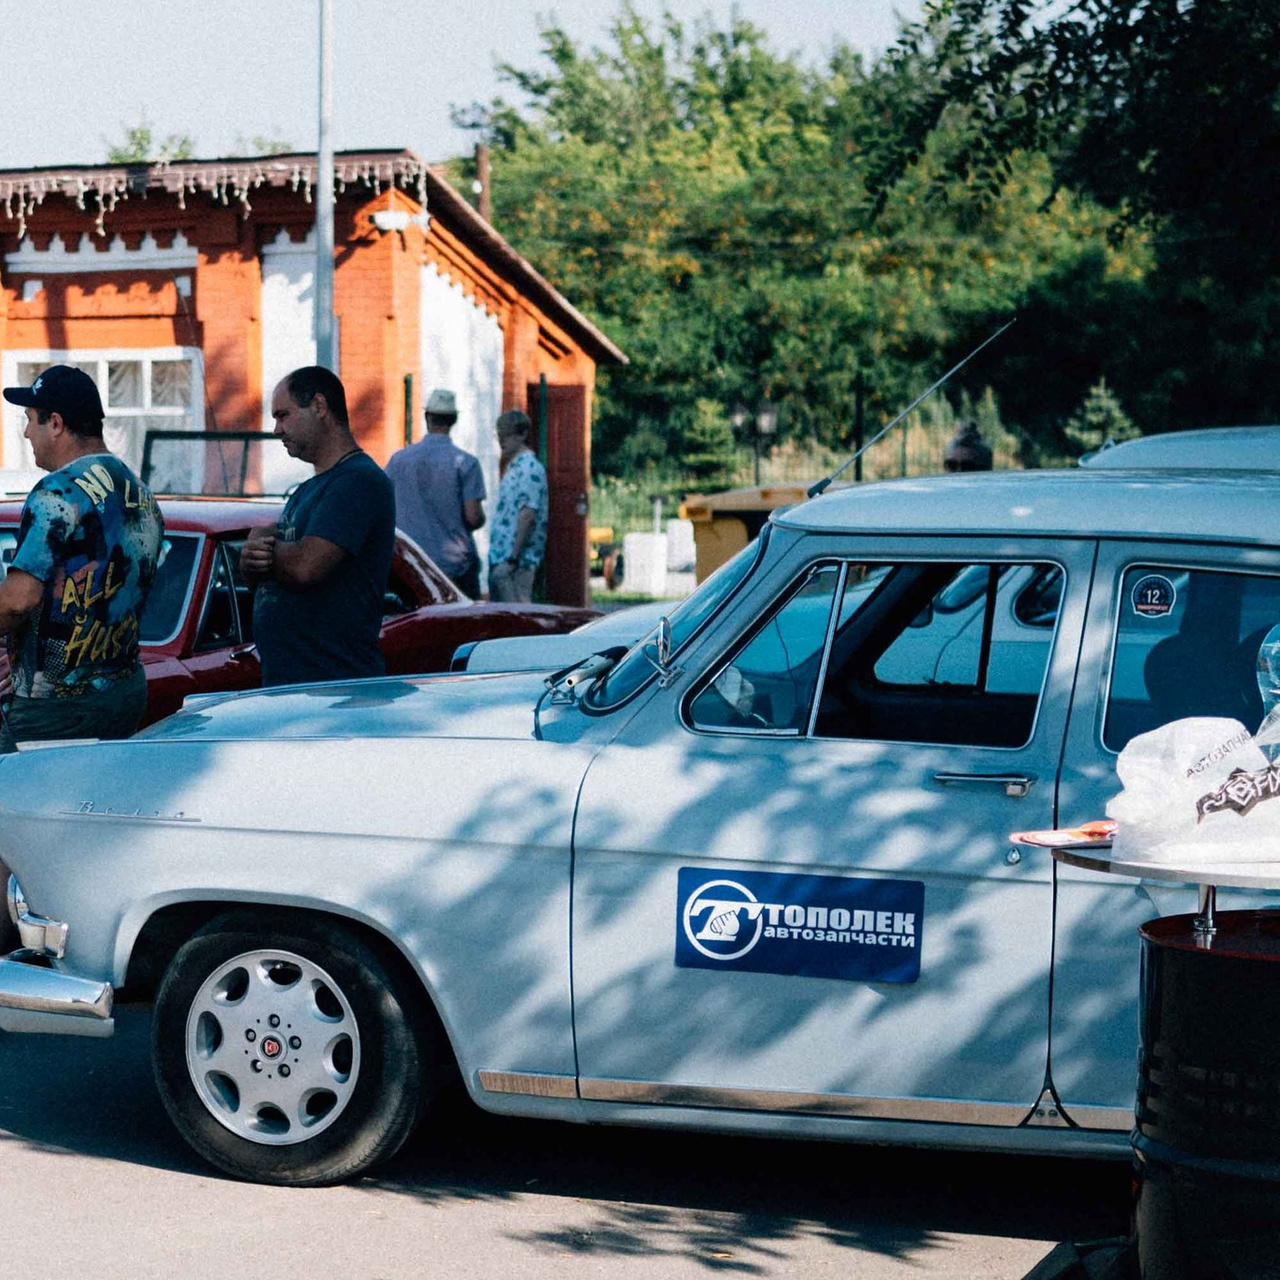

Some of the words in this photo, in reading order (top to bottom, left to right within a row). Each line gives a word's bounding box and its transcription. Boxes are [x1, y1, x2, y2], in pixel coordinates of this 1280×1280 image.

[74, 463, 115, 507] NO
[62, 561, 122, 614] ALL
[1147, 589, 1161, 604] 12
[763, 902, 916, 935] ТОПОЛЕК
[763, 926, 916, 949] автозапчасти
